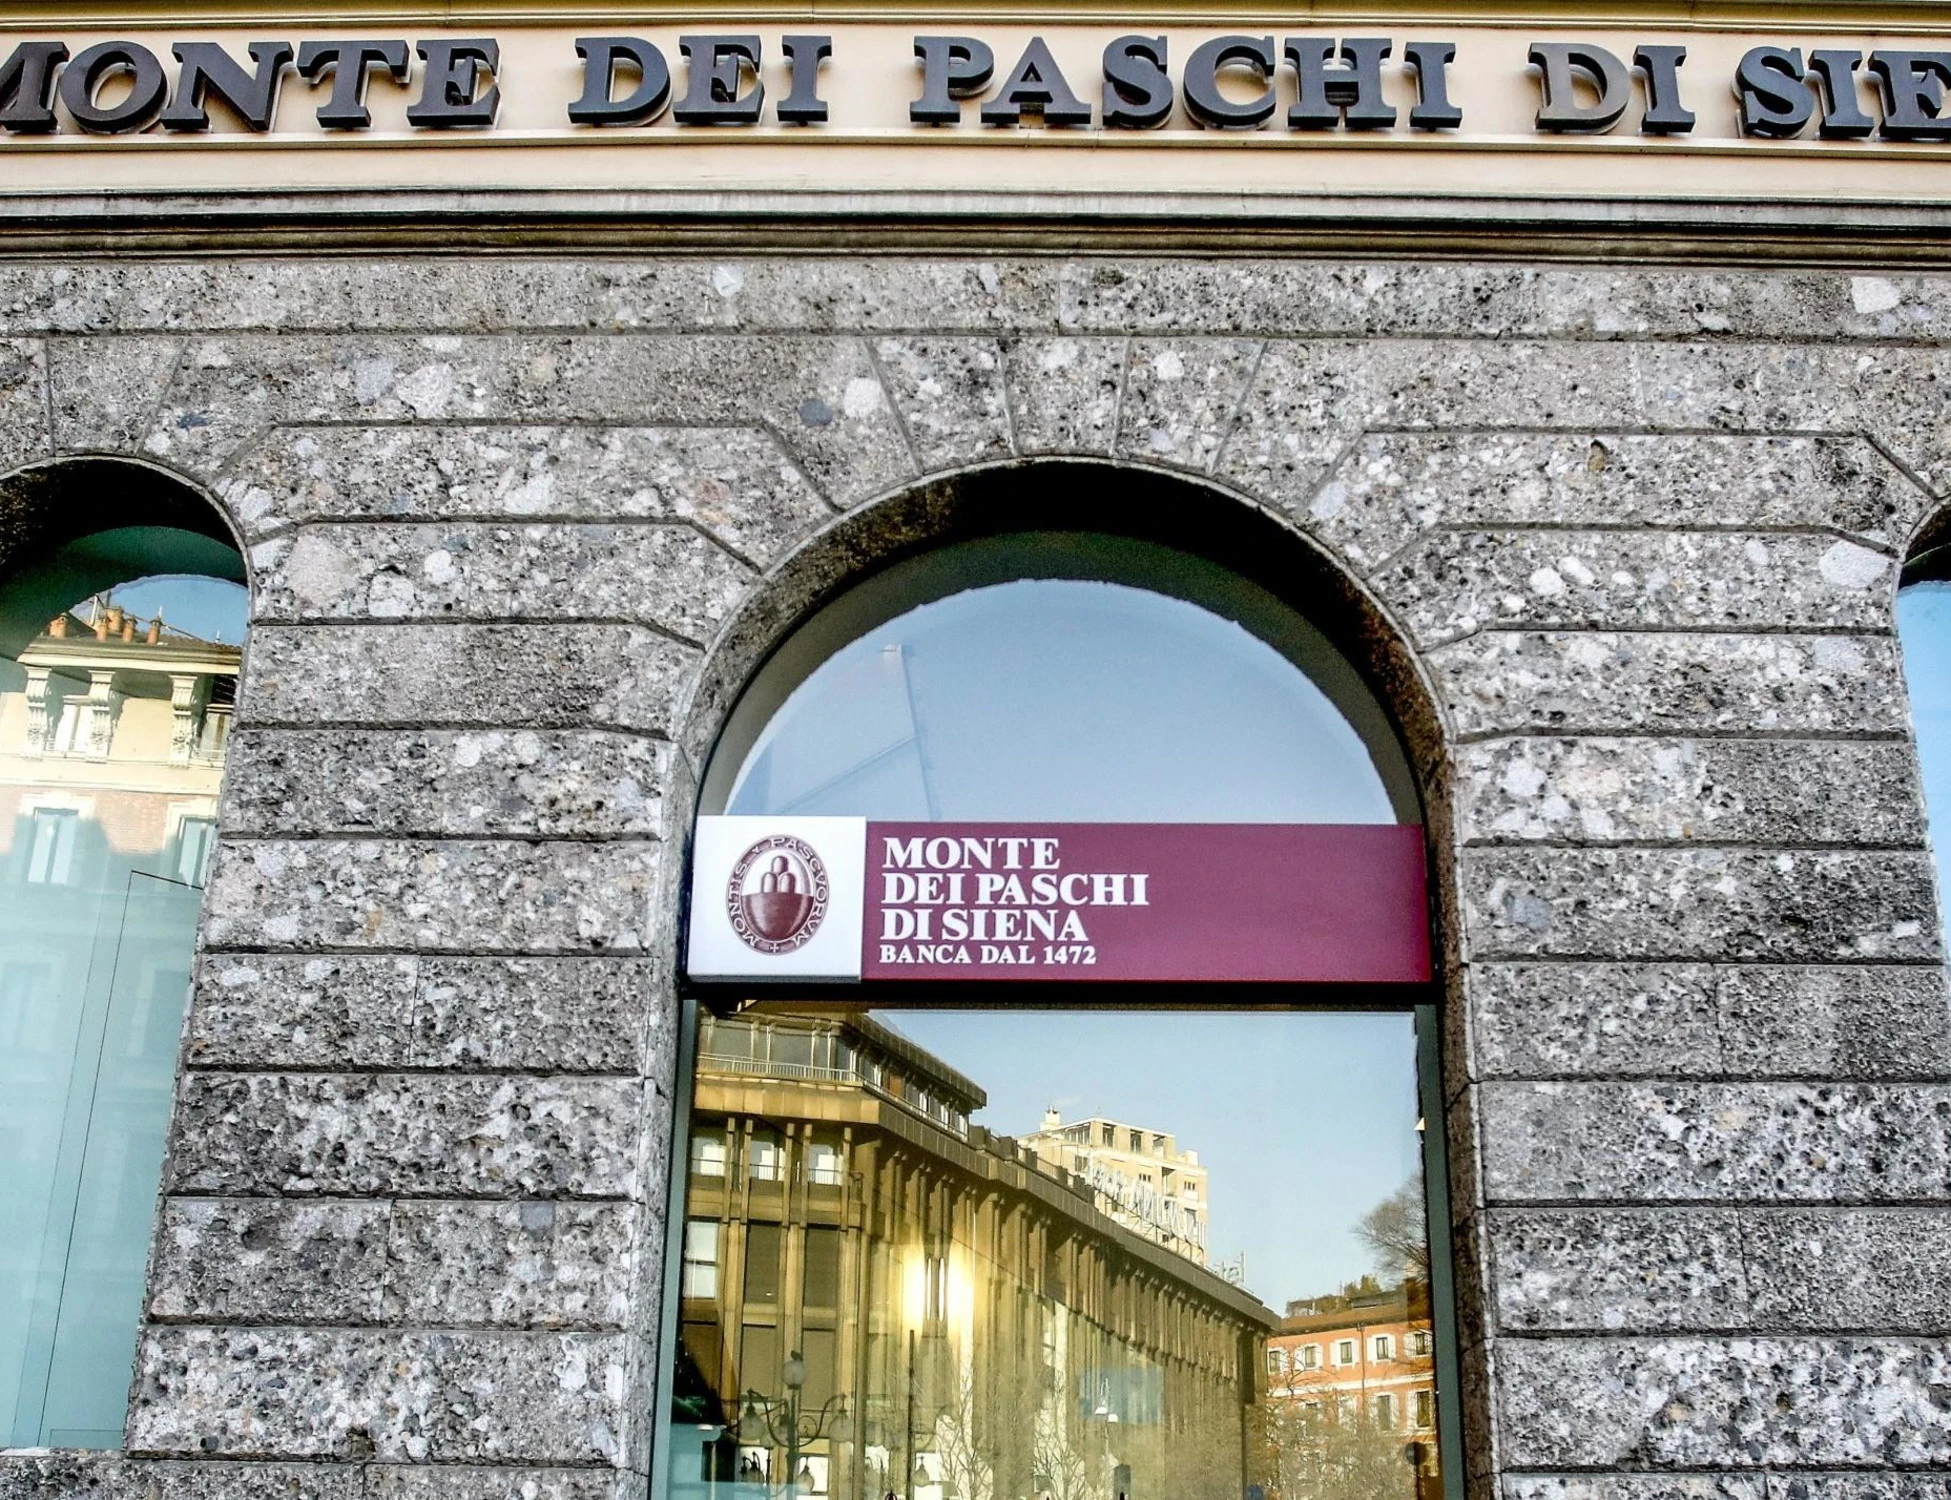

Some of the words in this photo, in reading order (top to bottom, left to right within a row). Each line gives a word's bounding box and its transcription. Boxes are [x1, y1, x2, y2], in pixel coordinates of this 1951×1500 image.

[567, 35, 832, 127] DEI
[910, 36, 1463, 130] PASCHI
[1527, 42, 1696, 134] DI
[1735, 45, 1951, 140] SIE
[882, 836, 1060, 870] MONTE
[728, 861, 760, 947] MONTIS
[881, 872, 966, 905] DEI
[975, 873, 1149, 906] PASCHI
[880, 908, 933, 940] DI
[941, 908, 1089, 942] SIENA
[879, 944, 972, 964] BANCA
[980, 944, 1036, 964] DAL
[1043, 945, 1097, 965] 1472
